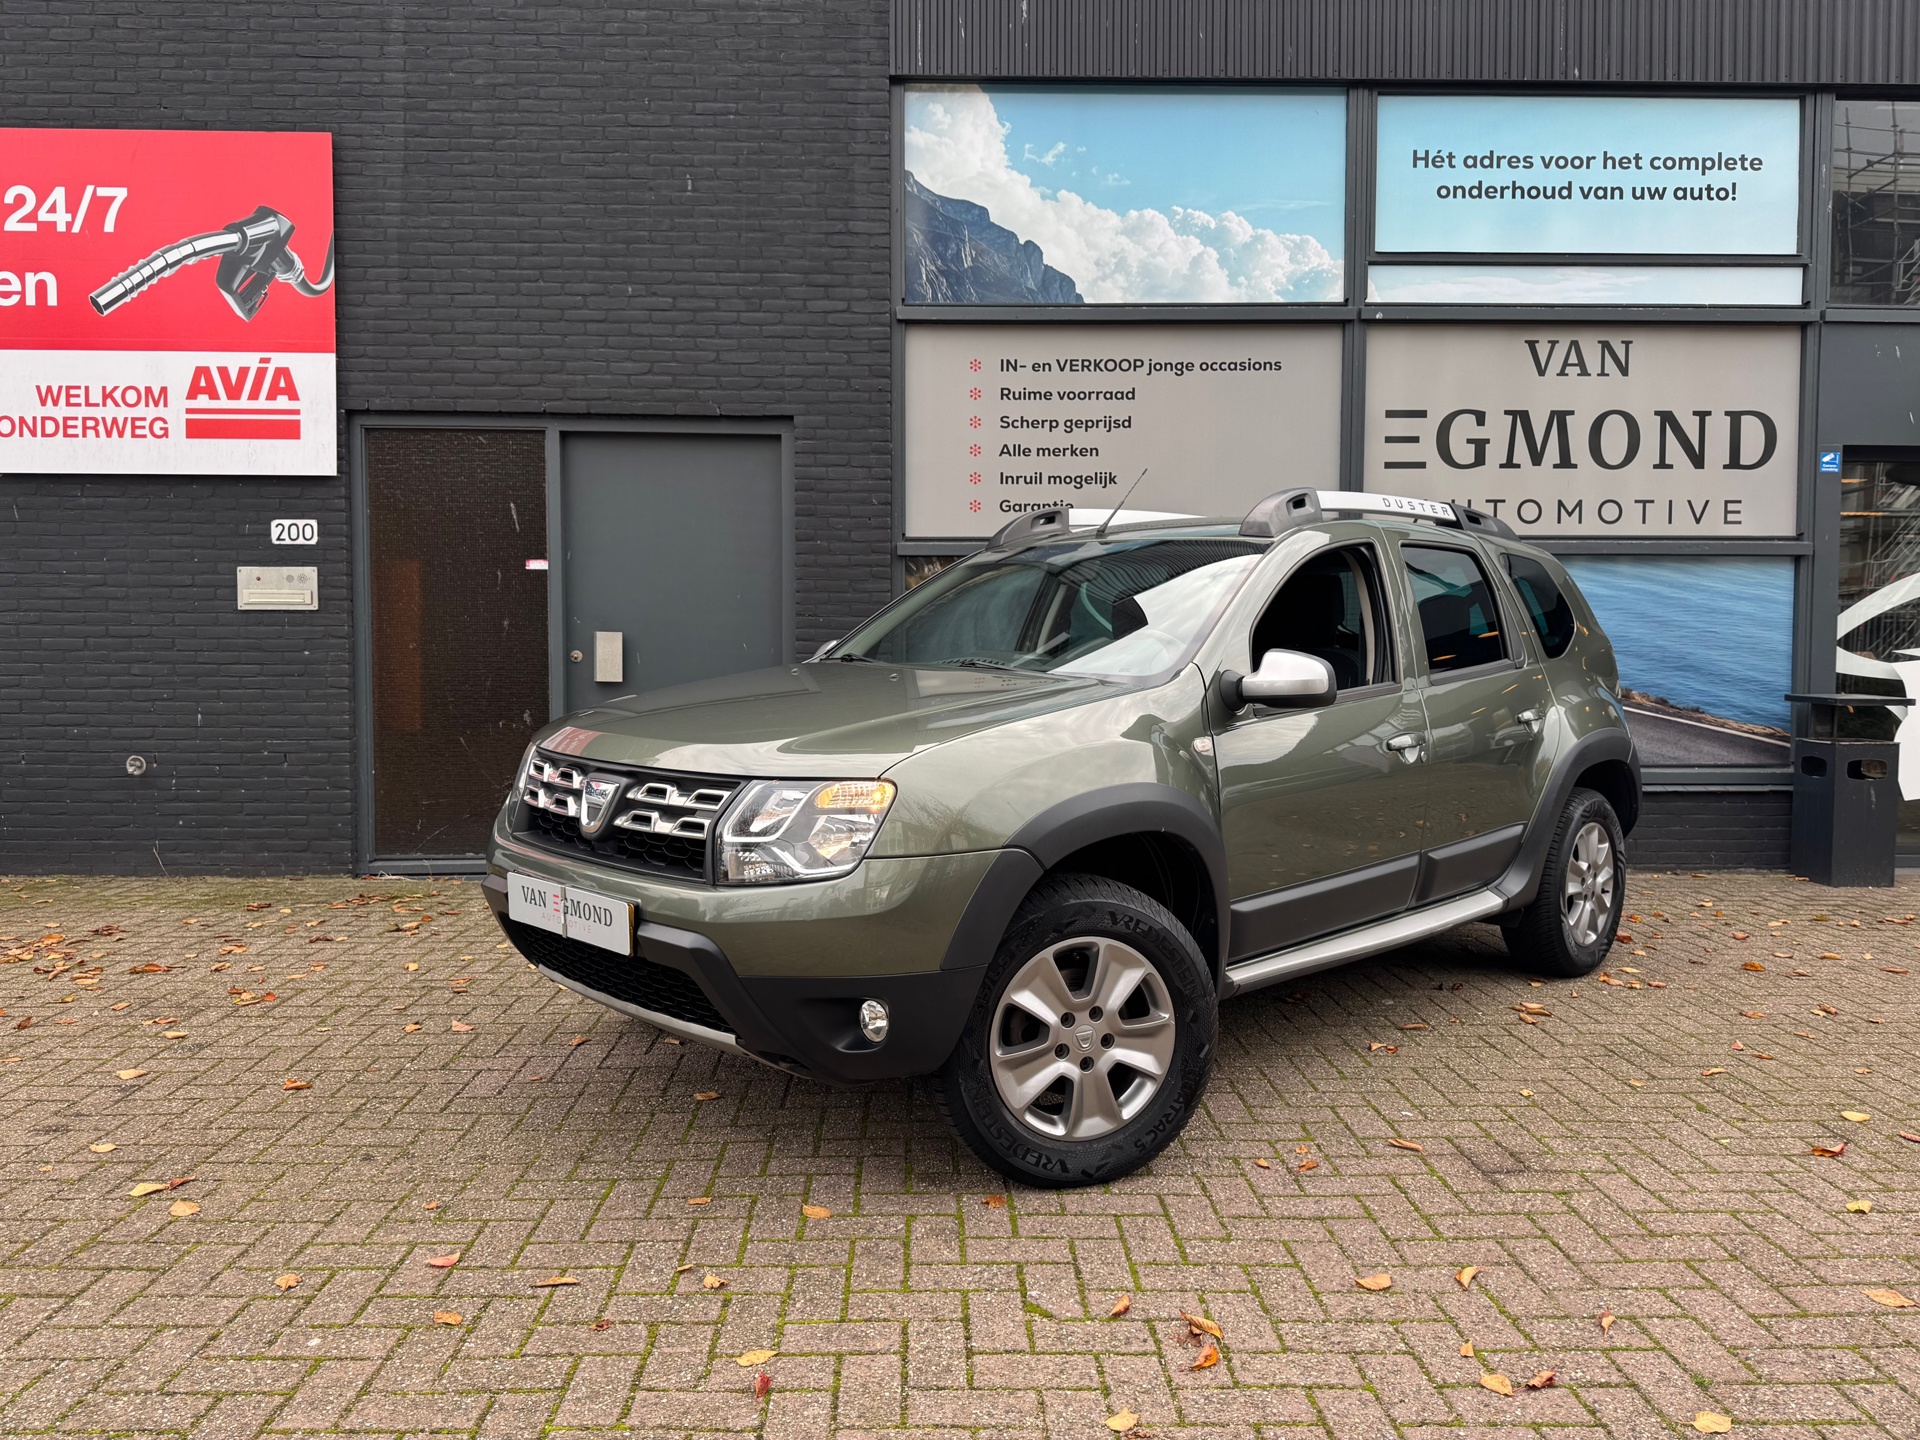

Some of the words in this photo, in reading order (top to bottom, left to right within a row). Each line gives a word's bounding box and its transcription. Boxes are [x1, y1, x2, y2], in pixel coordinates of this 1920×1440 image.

[1412, 149, 1456, 169] Hét
[1462, 150, 1534, 170] adres
[1540, 155, 1597, 170] voor
[1602, 150, 1643, 170] het
[1649, 151, 1763, 172] complete
[1436, 180, 1573, 200] onderhoud
[1578, 186, 1624, 200] van
[1631, 186, 1668, 201] uw
[1673, 182, 1737, 201] auto!
[3, 184, 128, 234] 24/7
[0, 270, 58, 307] en
[1000, 358, 1027, 373] IN-
[1031, 362, 1052, 373] en
[1055, 358, 1145, 373] VERKOOP
[1147, 358, 1195, 376] jonge
[1199, 358, 1282, 372] occasions
[1524, 339, 1634, 377] VAN
[185, 357, 300, 402] AVIA
[35, 385, 169, 409] WELKOM
[1000, 387, 1053, 401] Ruime
[1057, 387, 1136, 401] voorraad
[0, 415, 169, 440] ONDERWEG
[999, 415, 1060, 433] Scherp
[1064, 415, 1132, 433] geprijsd
[999, 443, 1032, 457] Alle
[1036, 443, 1099, 457] merken
[1383, 408, 1778, 470] EGMOND
[1000, 471, 1043, 485] Inruil
[1047, 471, 1118, 488] mogelijk
[1382, 497, 1450, 517] DUSTER
[1413, 498, 1742, 525] TOMOTIVE
[275, 523, 314, 541] 200
[585, 785, 607, 797] DACIA
[521, 885, 547, 909] VAN
[541, 912, 592, 934] AUTOOTIVE
